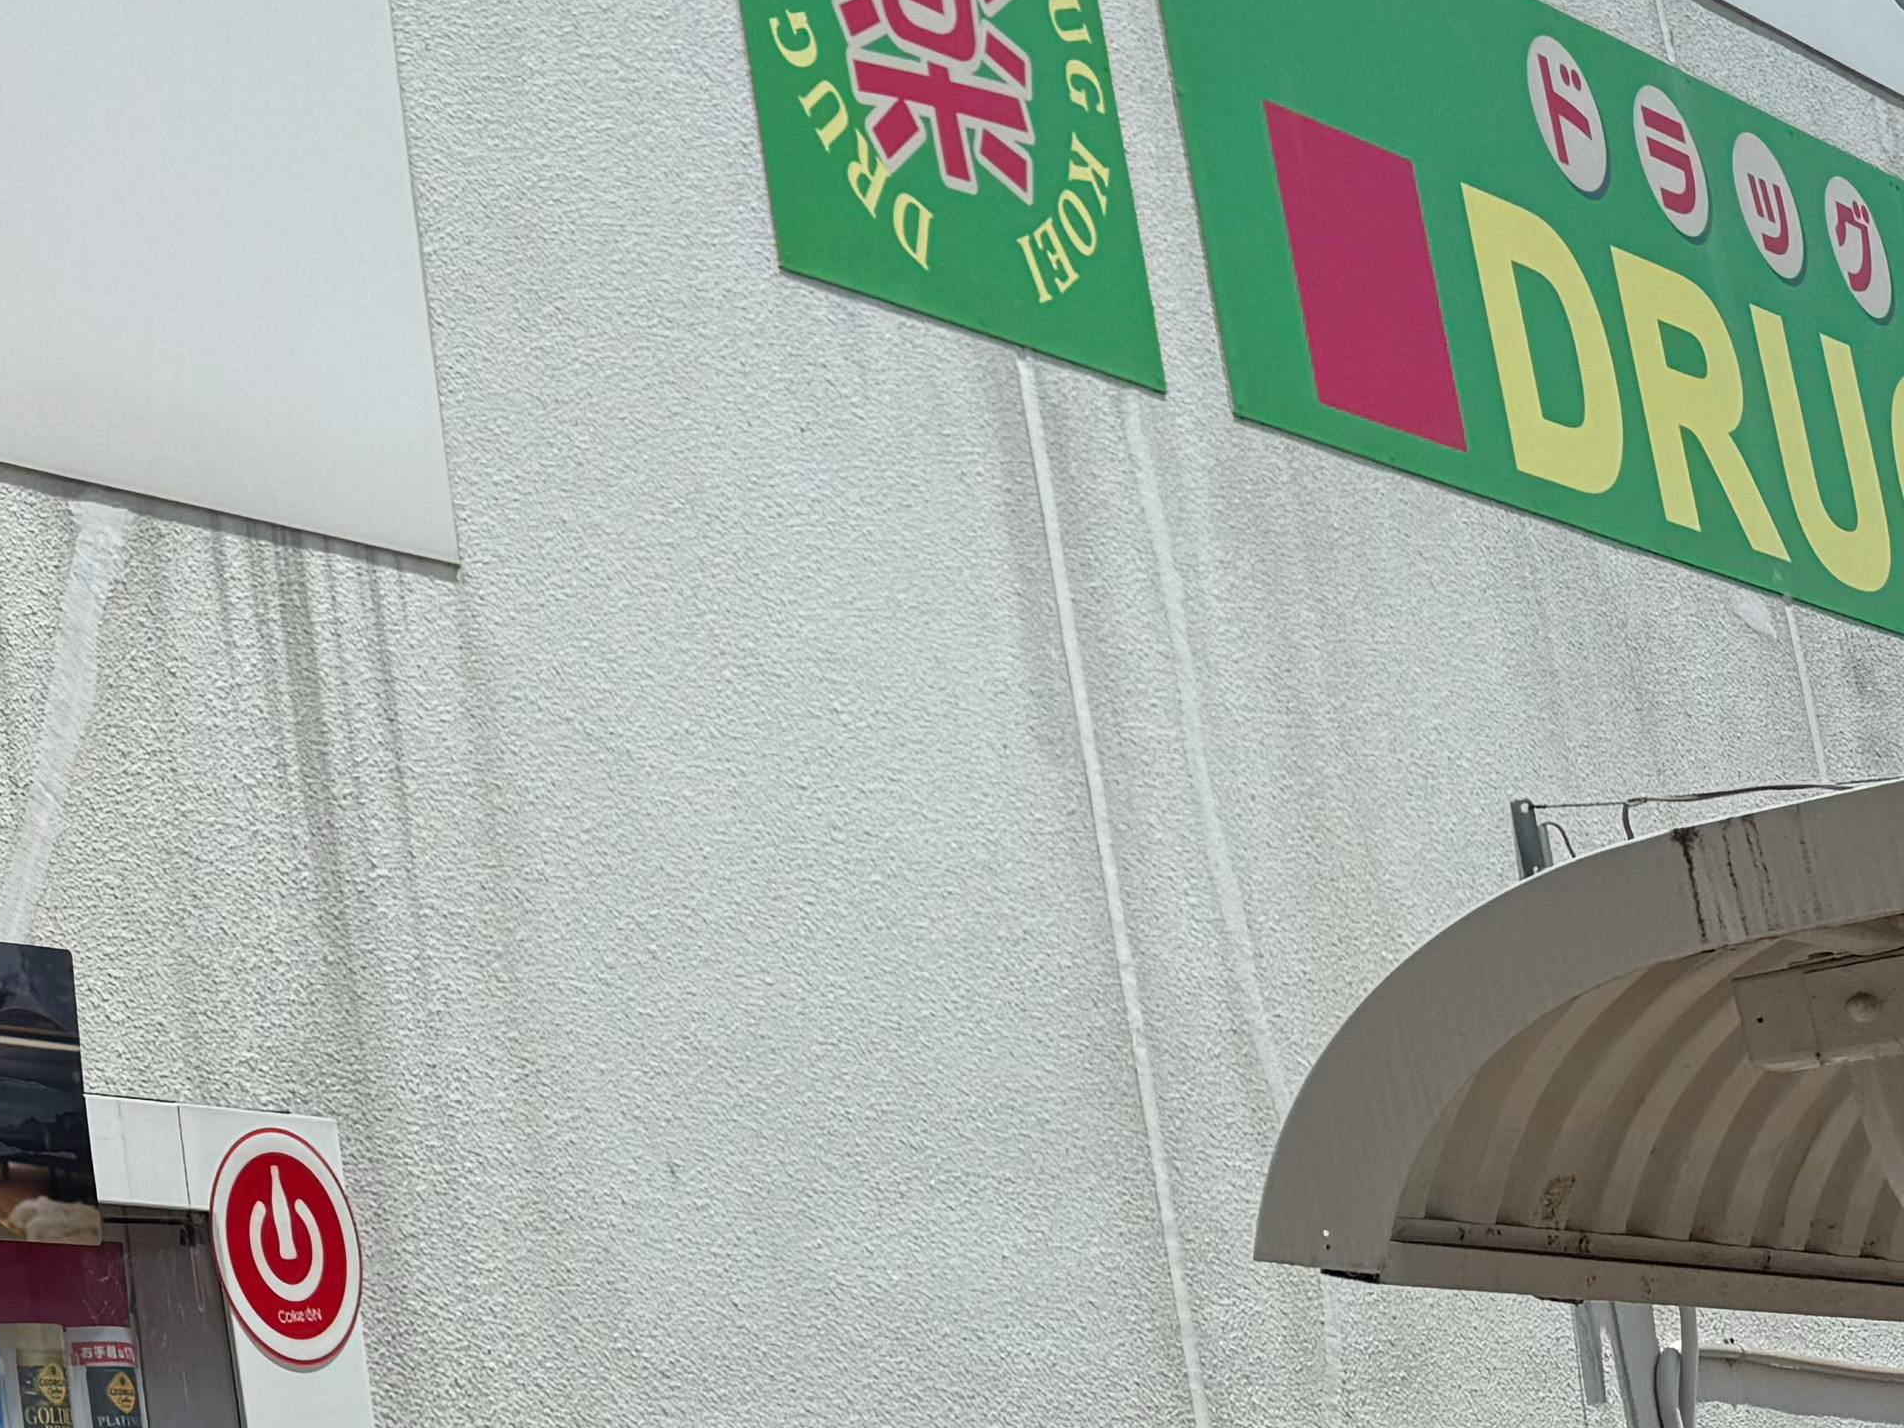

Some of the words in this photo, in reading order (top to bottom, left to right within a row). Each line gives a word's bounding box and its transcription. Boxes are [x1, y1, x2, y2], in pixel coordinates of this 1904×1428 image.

[768, 6, 934, 271] DRUG
[1016, 137, 1111, 304] KOEI
[1537, 53, 1872, 293] ドラッグ
[1460, 181, 1904, 593] DRU
